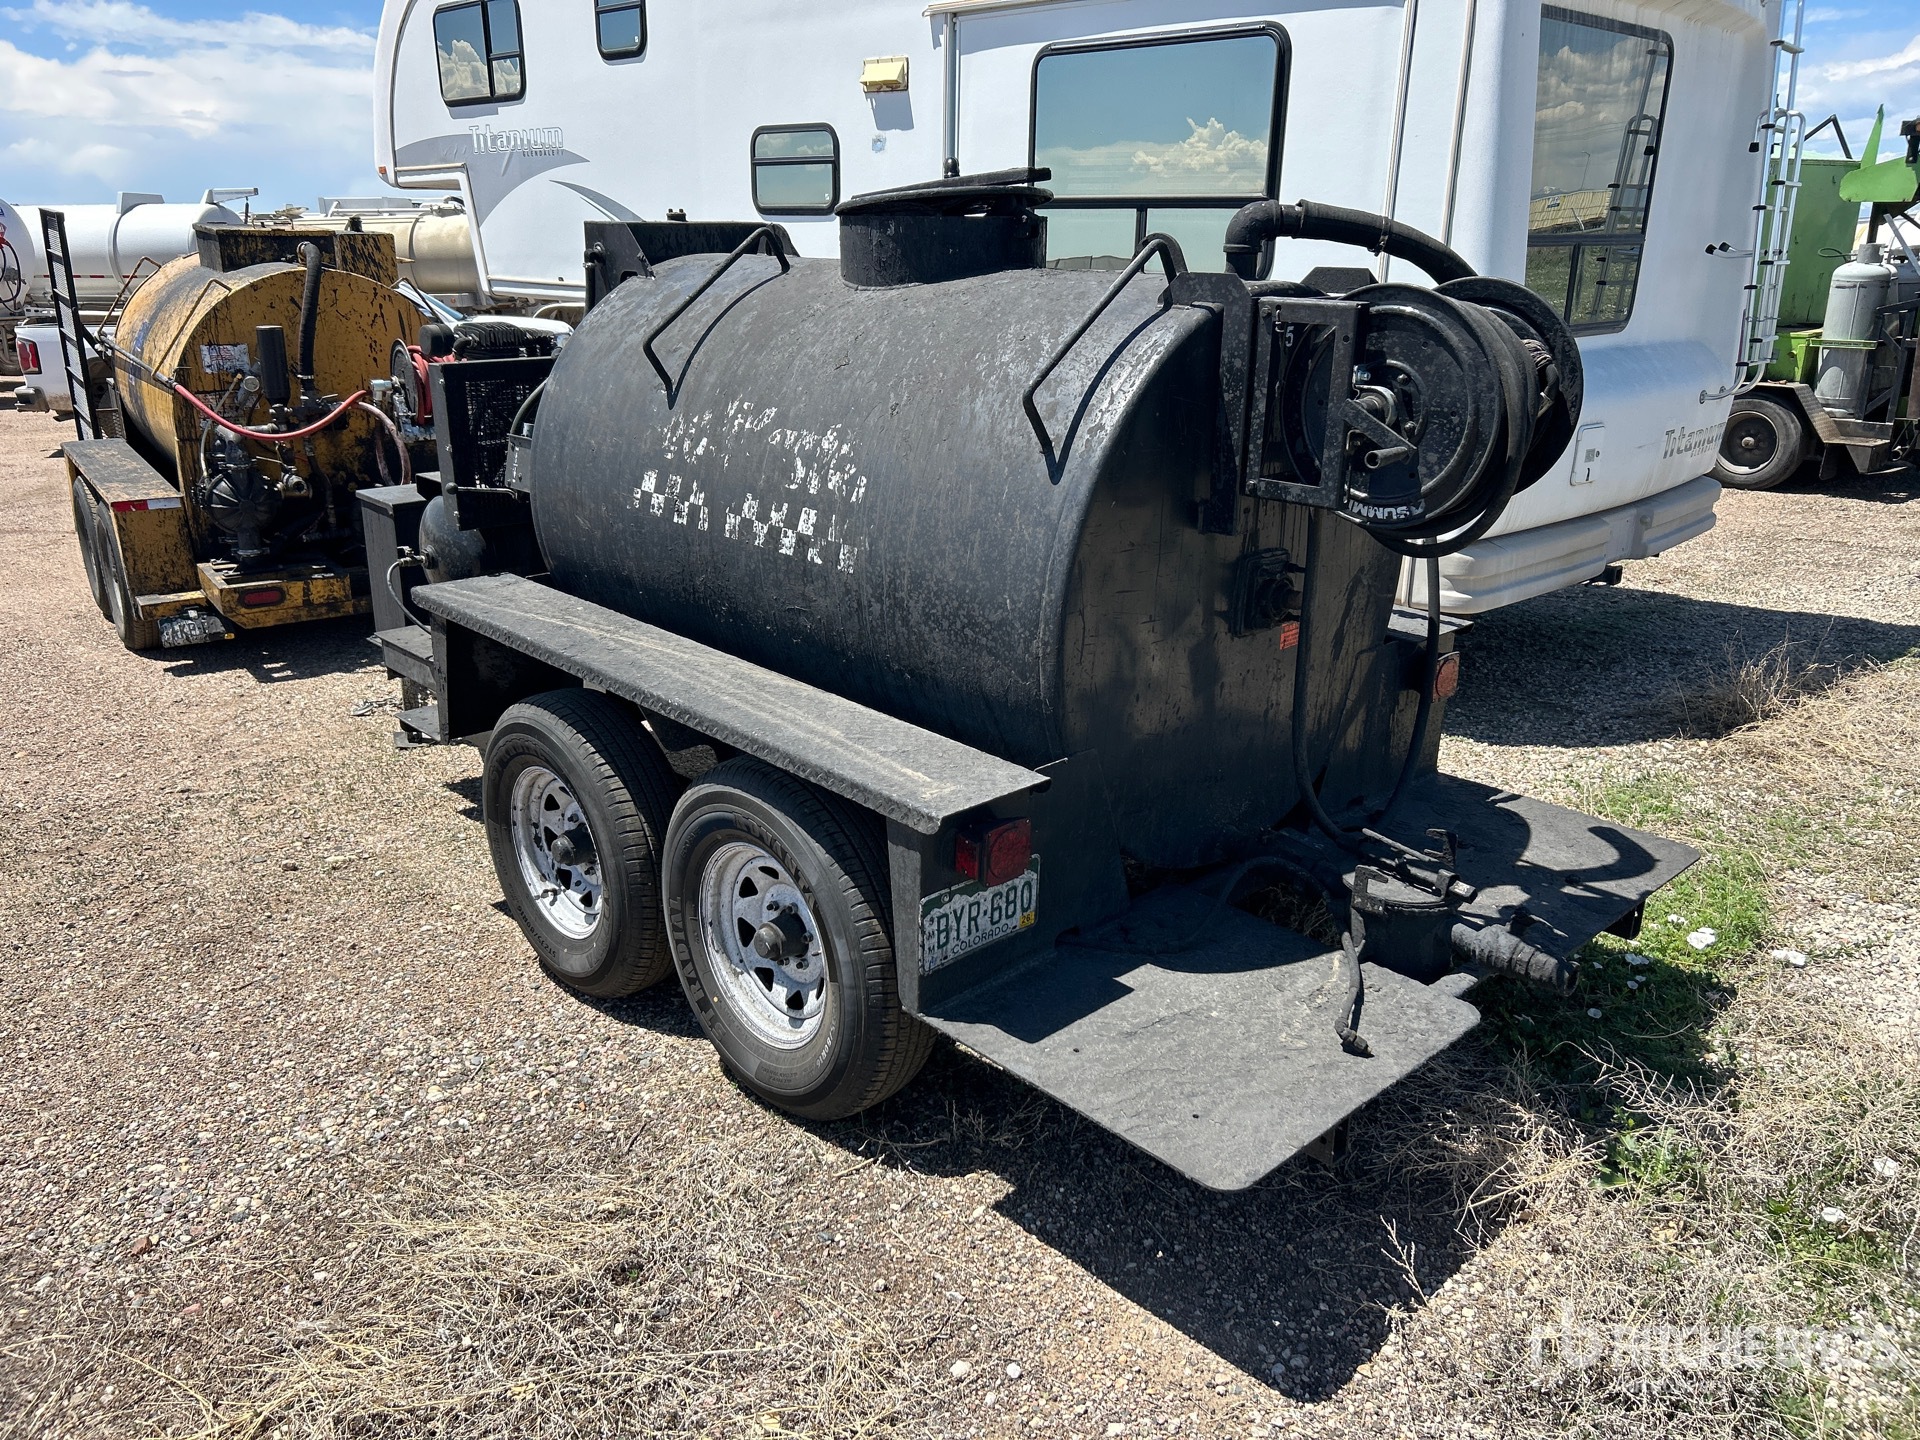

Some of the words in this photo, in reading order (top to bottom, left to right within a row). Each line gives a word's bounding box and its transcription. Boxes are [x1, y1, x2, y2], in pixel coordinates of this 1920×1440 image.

[469, 123, 564, 155] Titanium
[523, 148, 556, 158] GLENDALE
[1347, 499, 1410, 520] SUMMI
[668, 896, 706, 1004] RADIAL
[951, 922, 1009, 955] COLORADO
